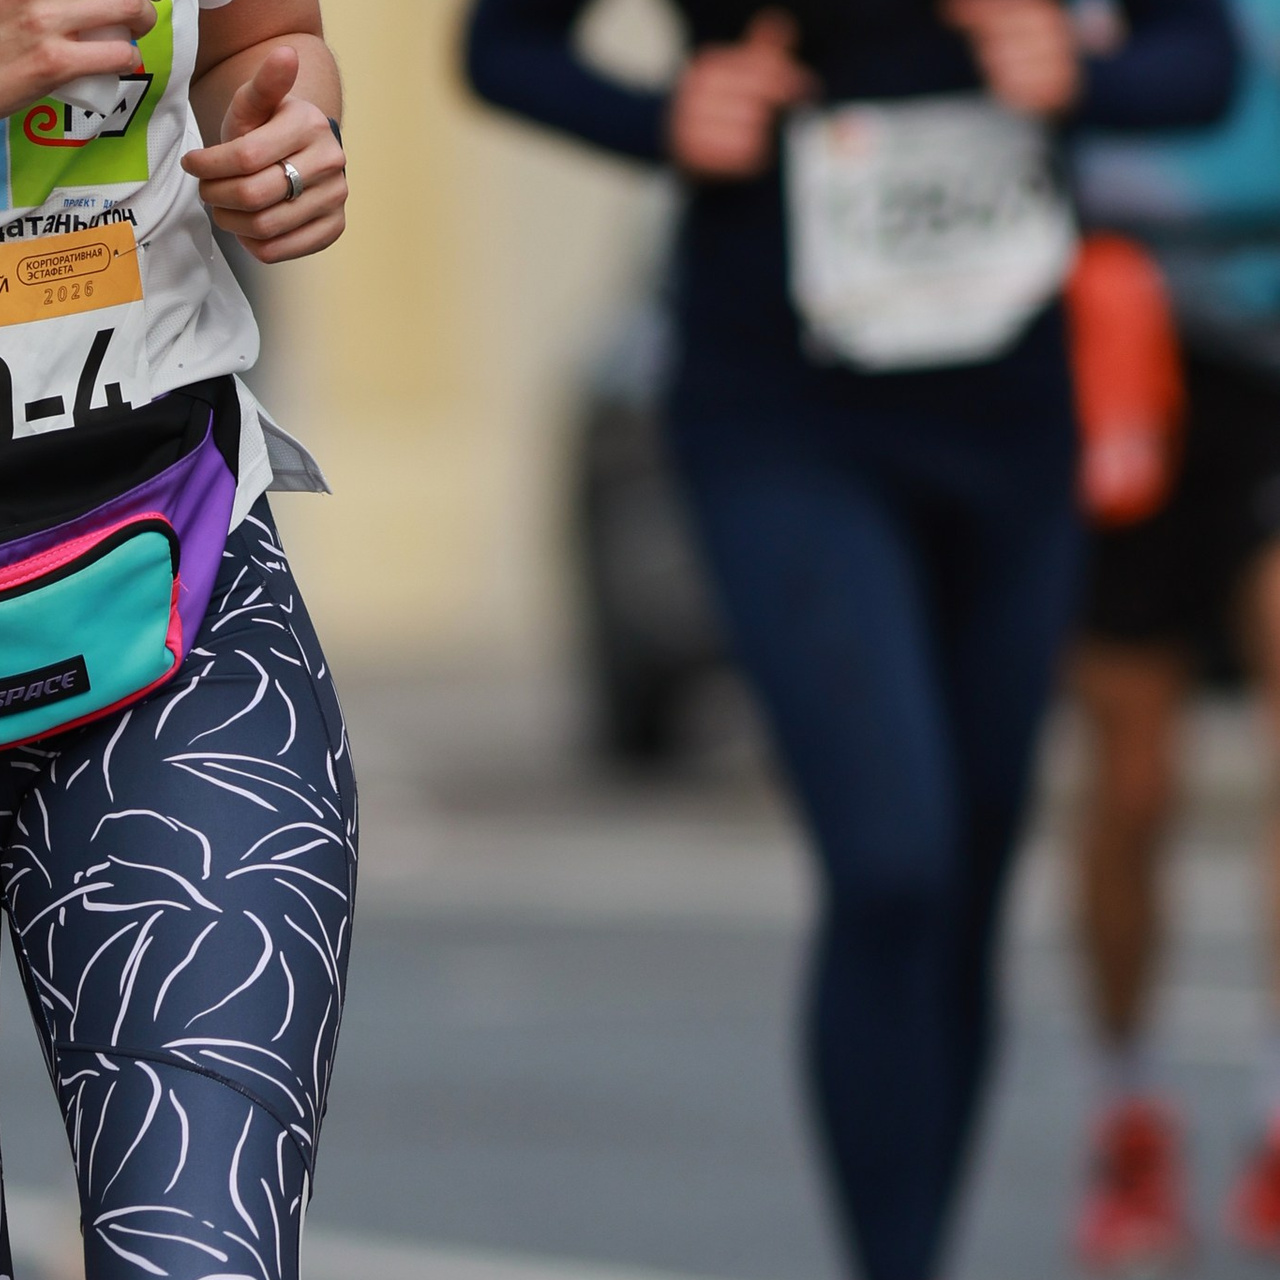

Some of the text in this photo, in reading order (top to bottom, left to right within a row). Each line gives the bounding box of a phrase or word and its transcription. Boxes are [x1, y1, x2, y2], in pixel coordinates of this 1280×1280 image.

[63, 198, 96, 209] ПРОЕКТ
[25, 247, 104, 271] КОРПОРАТИВНАЯ
[26, 264, 75, 281] ЭСТАФЕТА
[43, 280, 95, 306] 2026
